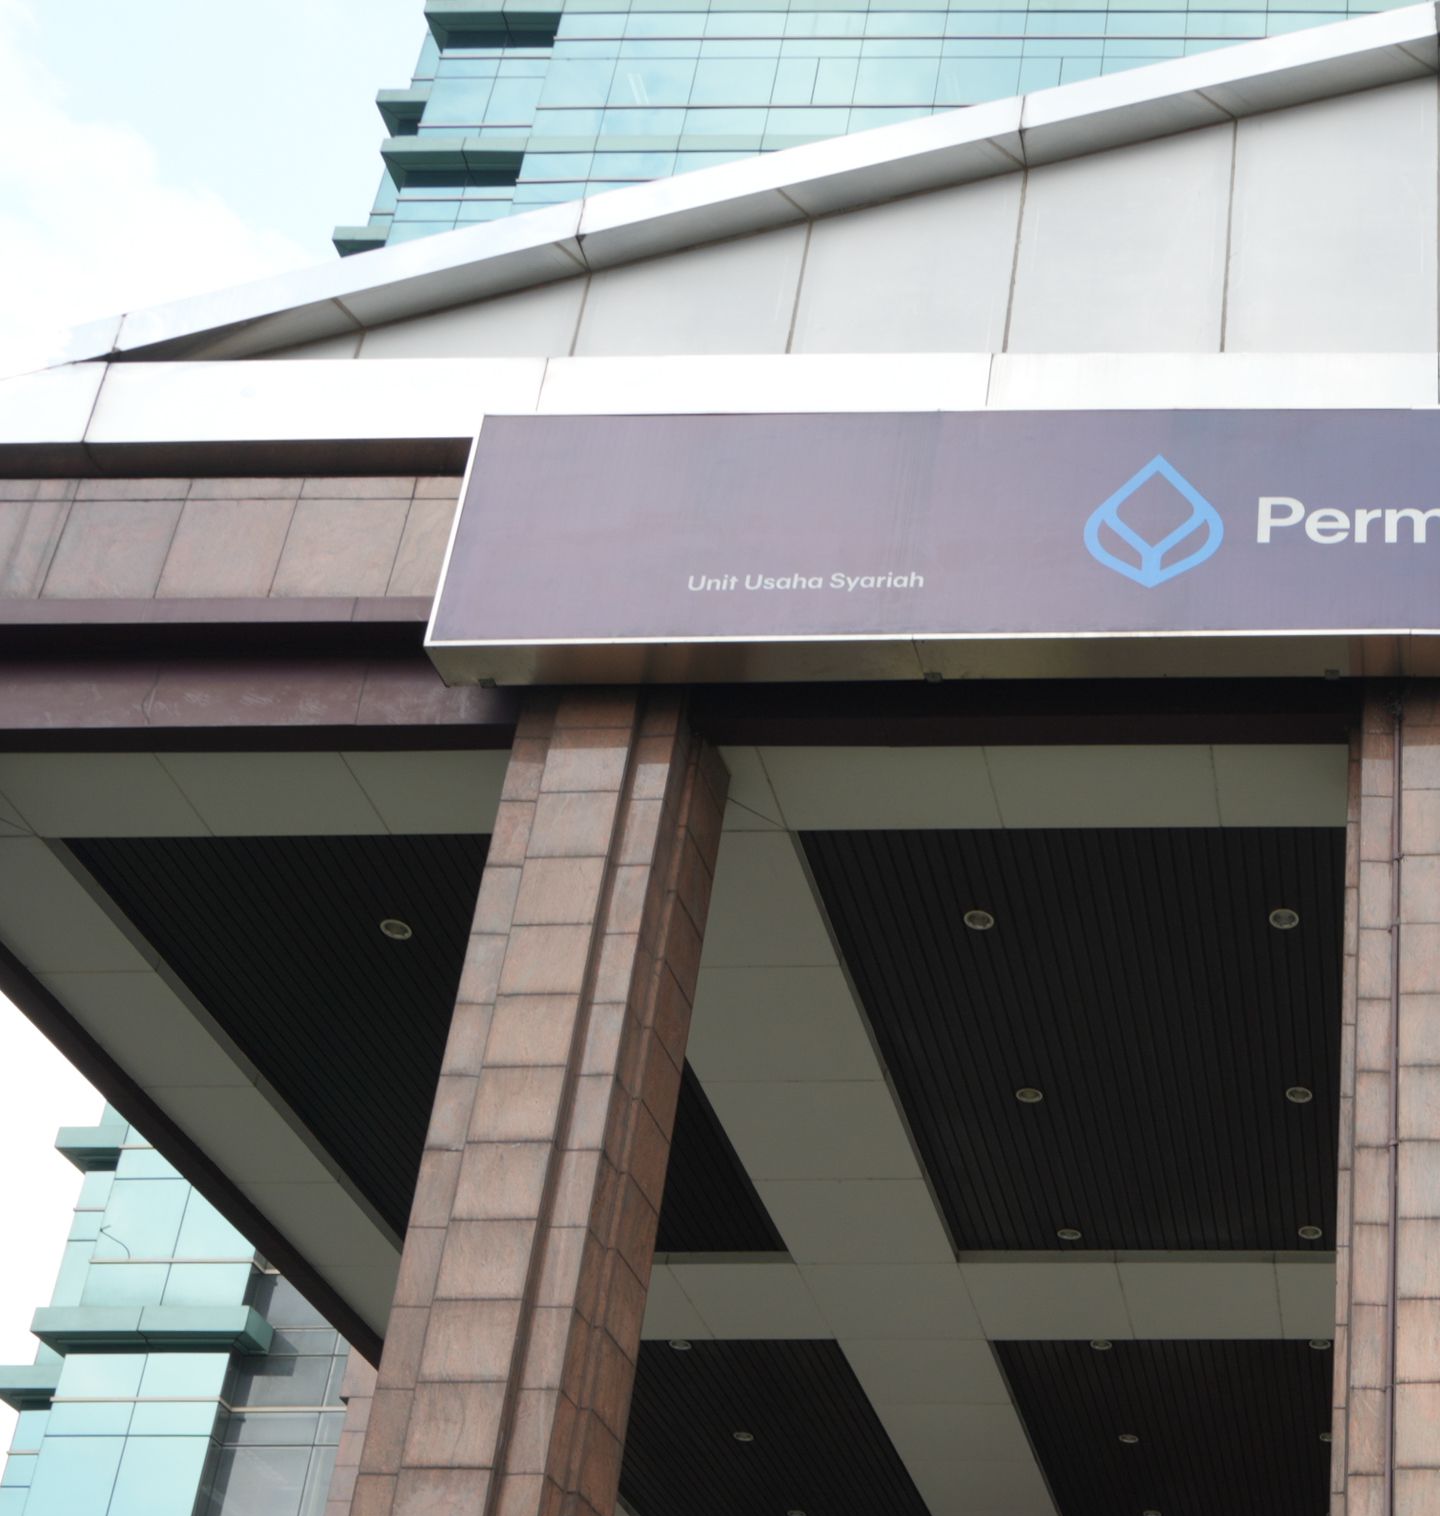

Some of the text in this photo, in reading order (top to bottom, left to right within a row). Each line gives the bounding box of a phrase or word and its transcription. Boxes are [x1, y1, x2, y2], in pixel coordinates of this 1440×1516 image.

[687, 571, 925, 592] Unit Usaha Syariah
